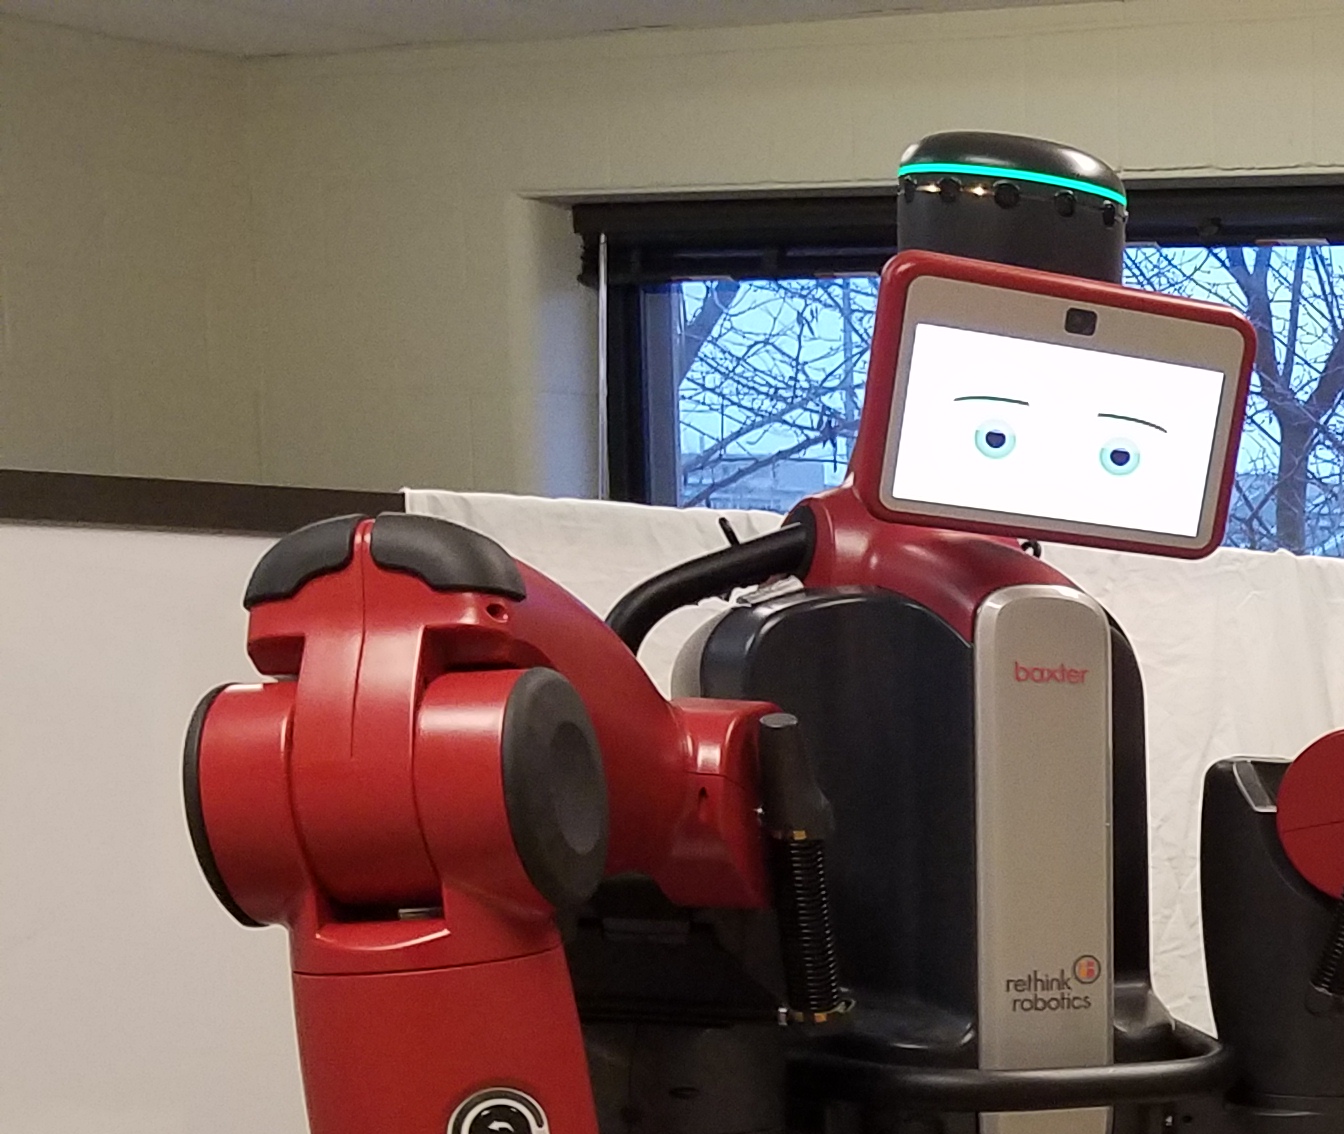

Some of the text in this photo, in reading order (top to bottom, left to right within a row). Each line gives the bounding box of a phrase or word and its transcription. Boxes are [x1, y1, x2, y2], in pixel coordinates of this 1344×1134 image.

[1013, 662, 1090, 684] baxter
[1005, 969, 1073, 993] rethink
[1012, 991, 1092, 1012] robotics
